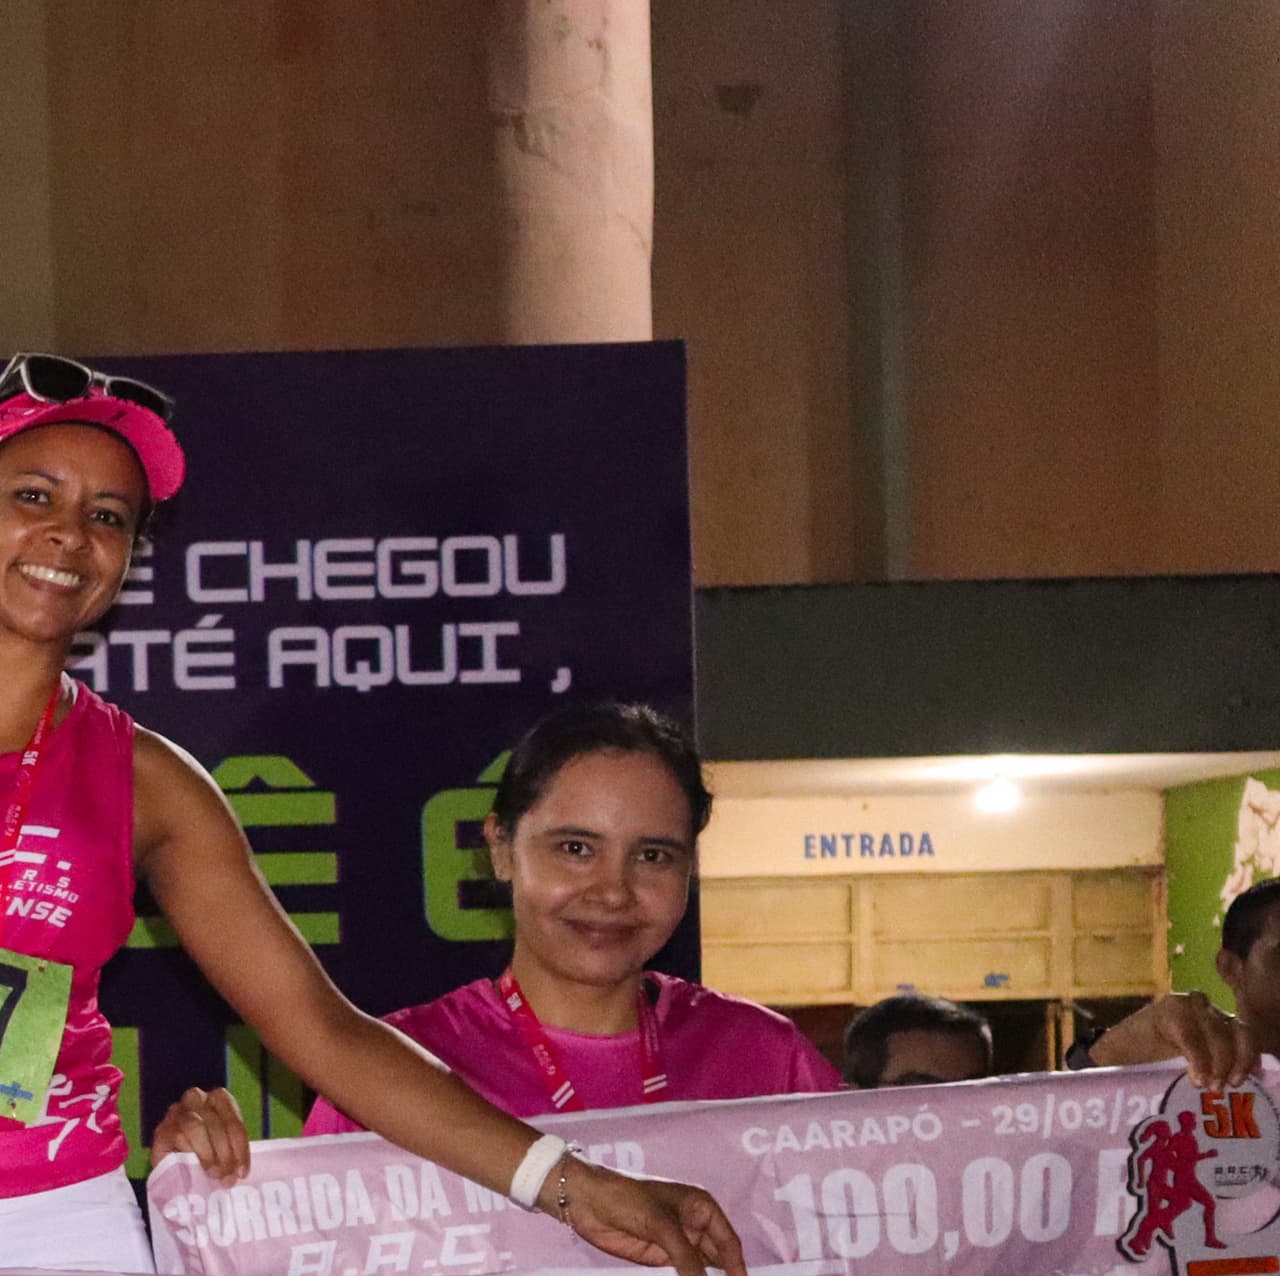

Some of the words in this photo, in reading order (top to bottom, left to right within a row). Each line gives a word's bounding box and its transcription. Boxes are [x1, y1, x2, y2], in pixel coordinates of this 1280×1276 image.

[185, 532, 567, 604] CHEGOU
[64, 613, 237, 693] ATÉ
[803, 832, 936, 859] ENTRADA
[741, 1103, 943, 1157] CAARAPÓ
[1200, 1091, 1262, 1139] 5K
[383, 1162, 453, 1223] DA
[774, 1152, 1073, 1263] 100,00
